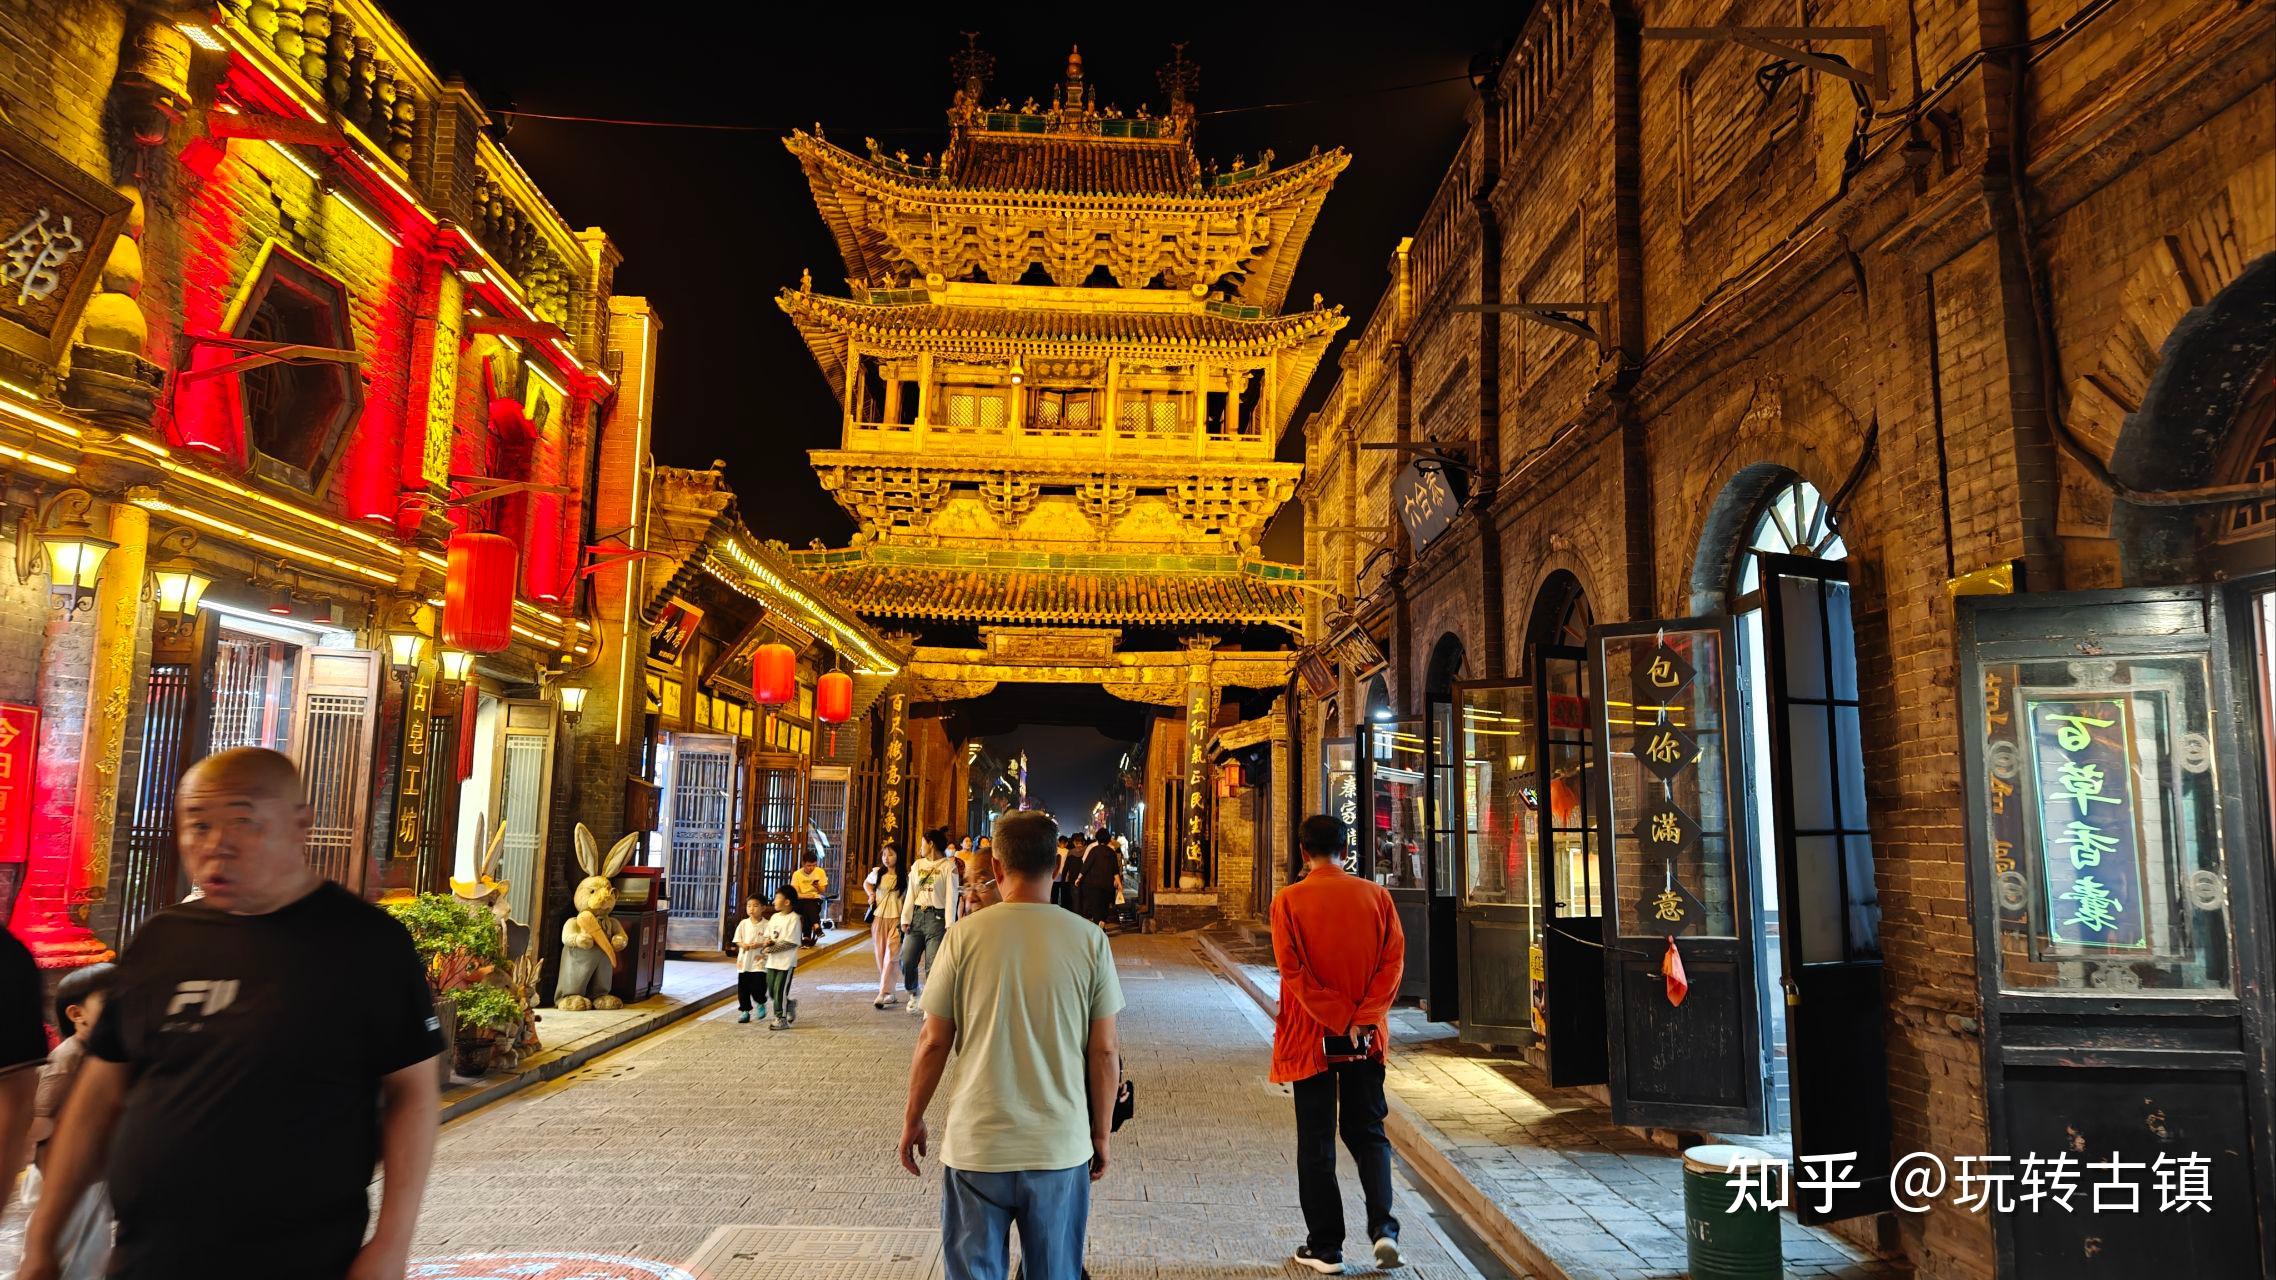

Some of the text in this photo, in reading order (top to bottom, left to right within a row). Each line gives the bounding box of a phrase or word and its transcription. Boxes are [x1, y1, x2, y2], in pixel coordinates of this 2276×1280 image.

[1646, 655, 1684, 921] 包你滿意
[2045, 713, 2123, 932] 百草香囊
